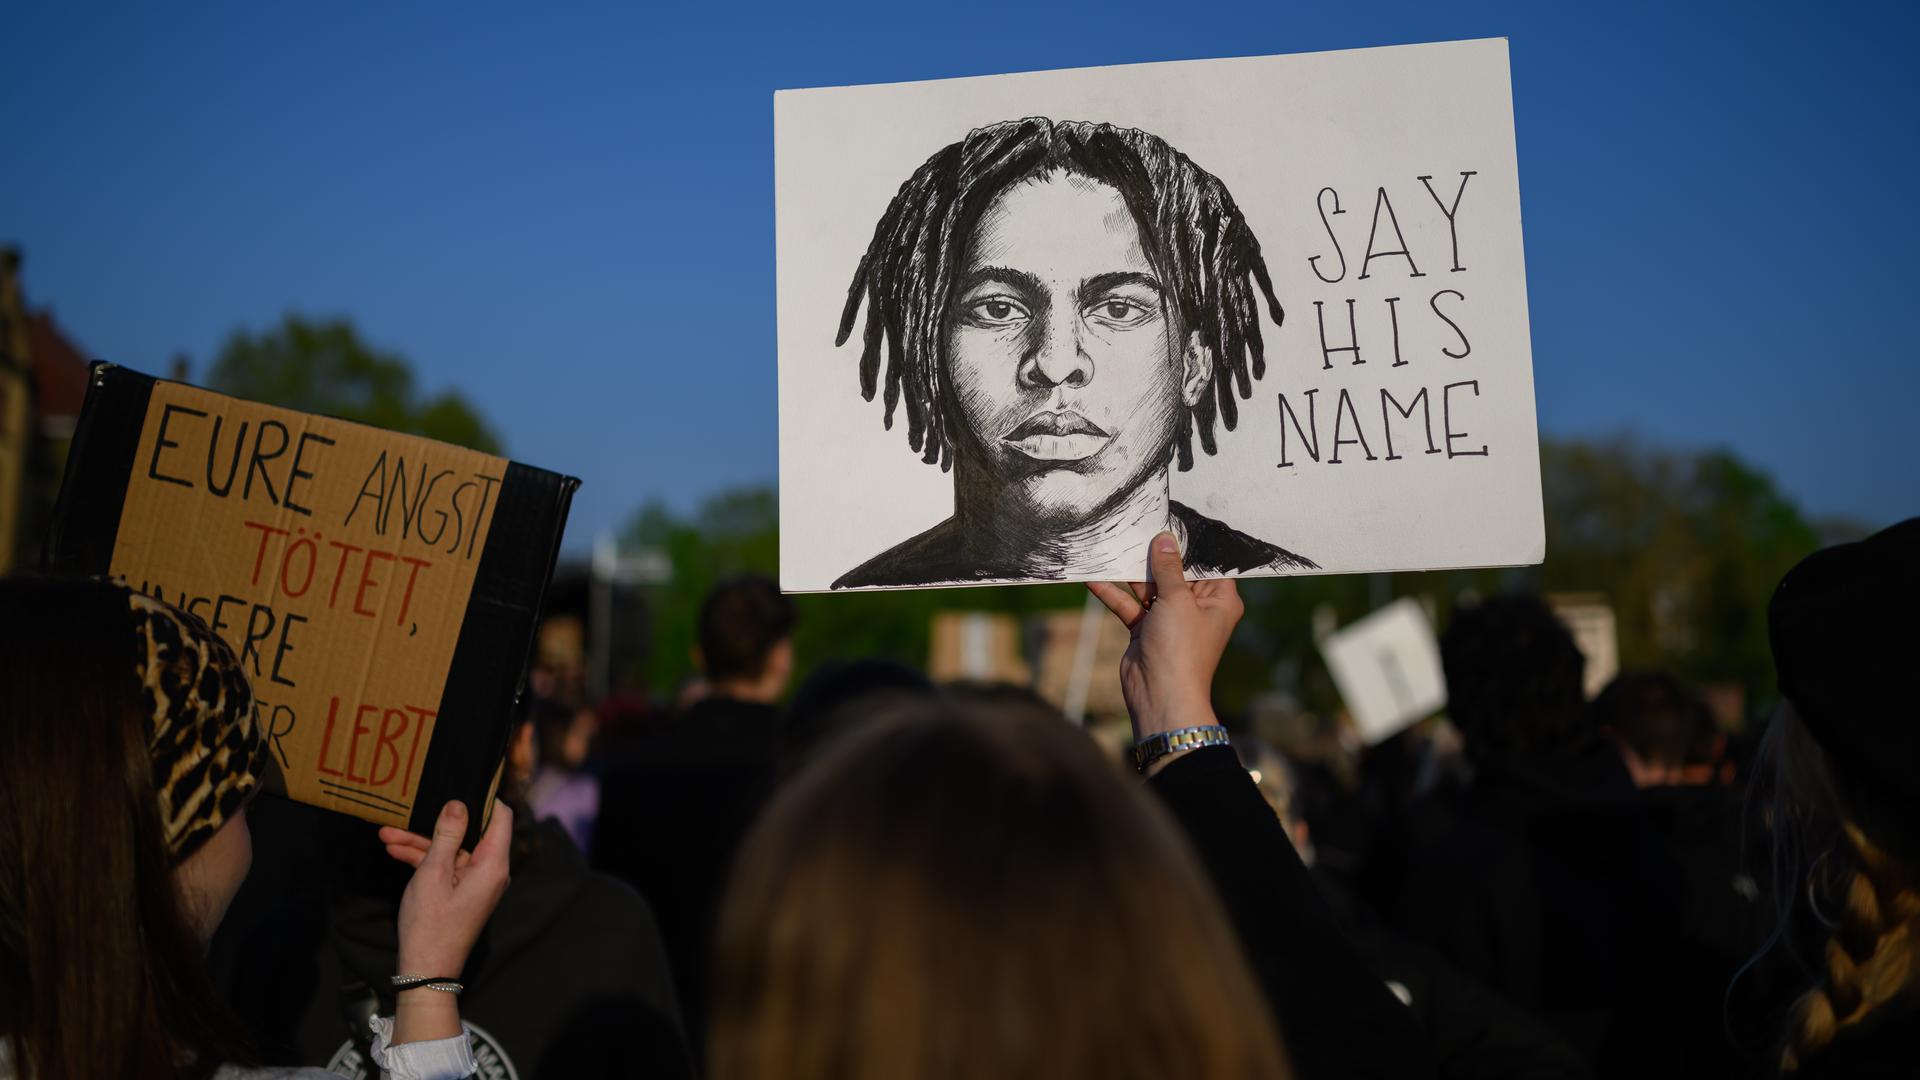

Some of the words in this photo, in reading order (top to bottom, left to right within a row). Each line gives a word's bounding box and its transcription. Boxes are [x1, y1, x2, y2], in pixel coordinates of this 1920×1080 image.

[1308, 171, 1478, 284] SAY
[1313, 289, 1471, 370] HIS
[1277, 380, 1489, 468] NAME
[148, 403, 336, 516] EURE
[344, 449, 501, 560] ANGST
[244, 521, 432, 636] TÖTET,
[316, 696, 438, 798] LEBT
